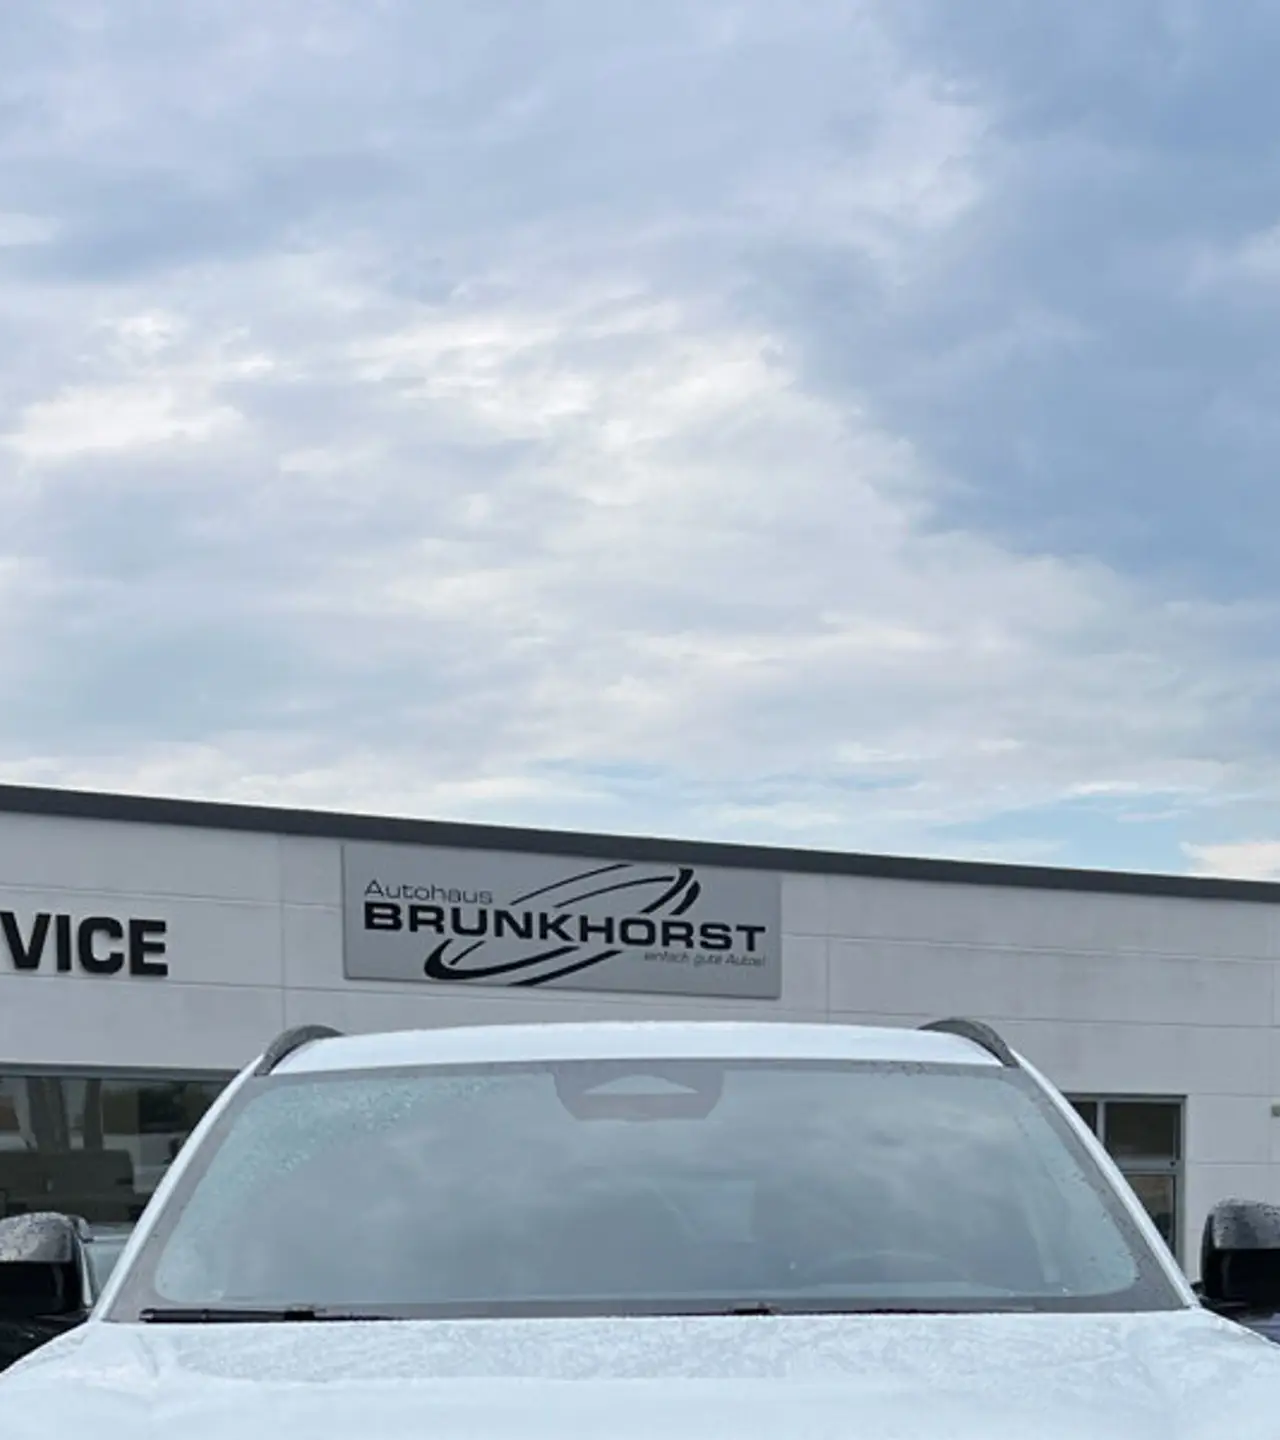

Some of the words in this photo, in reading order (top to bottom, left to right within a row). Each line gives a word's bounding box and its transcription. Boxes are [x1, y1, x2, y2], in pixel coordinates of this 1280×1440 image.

[364, 878, 493, 904] Autohaus
[363, 902, 766, 952] BRUNKHORST
[693, 953, 722, 967] gute
